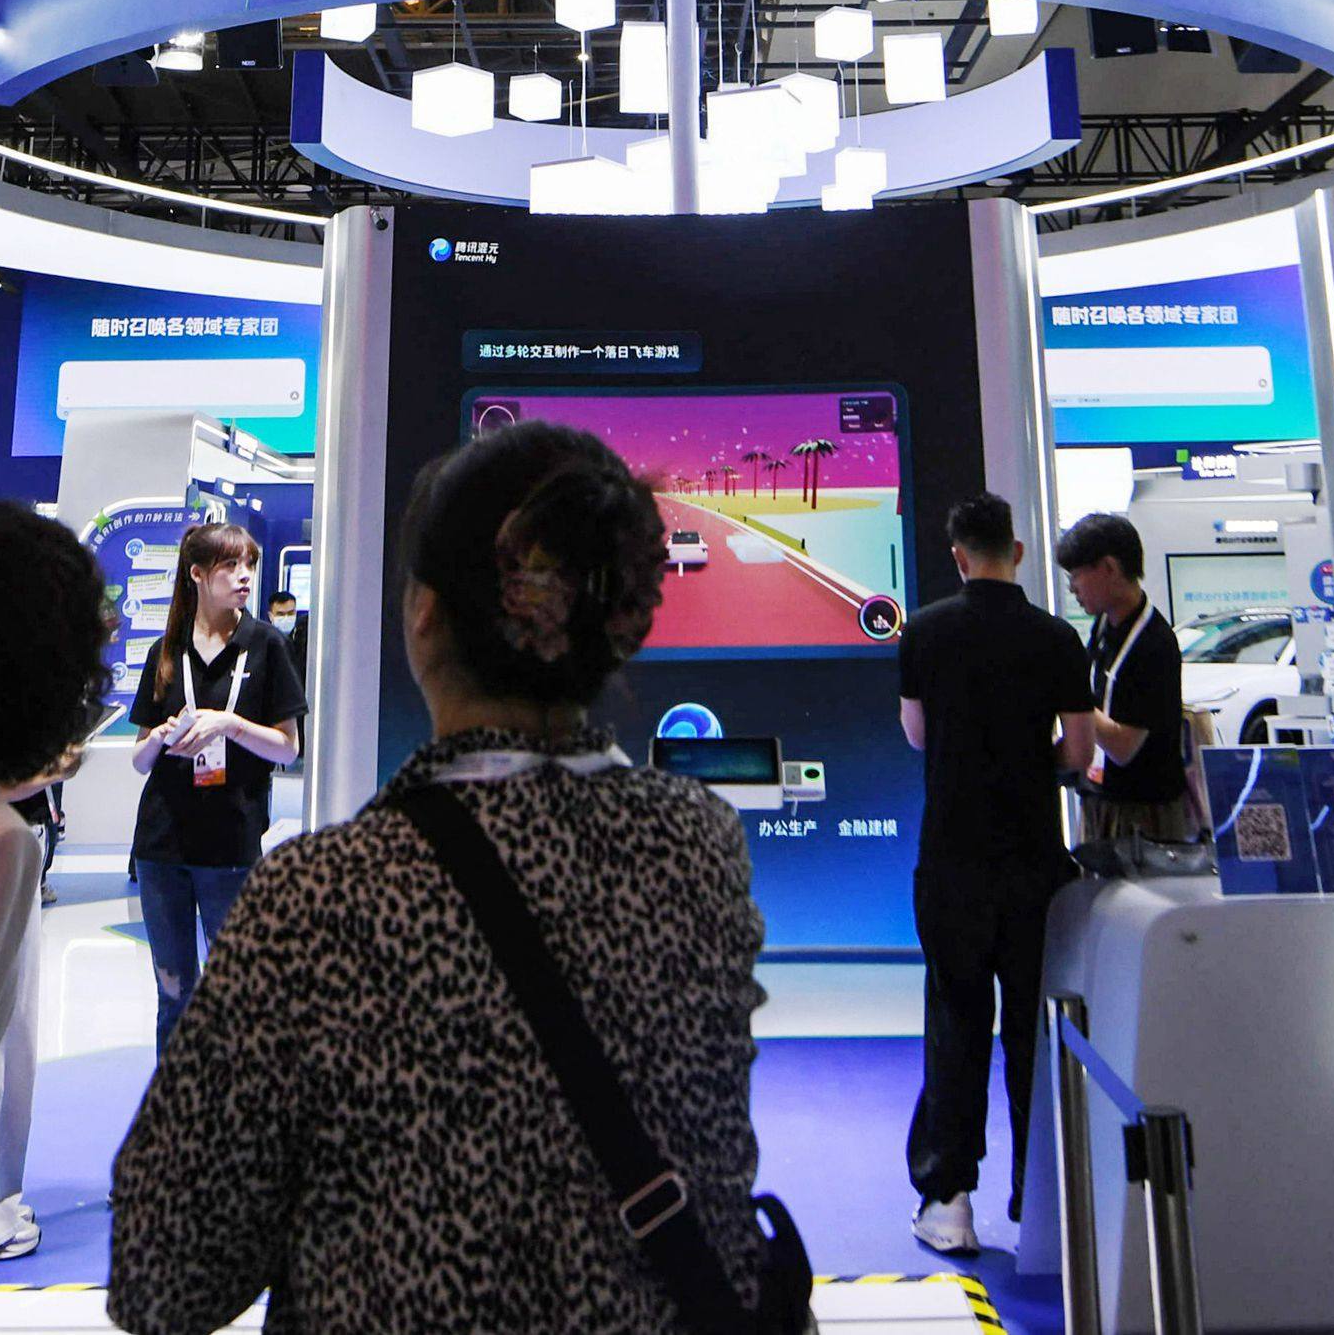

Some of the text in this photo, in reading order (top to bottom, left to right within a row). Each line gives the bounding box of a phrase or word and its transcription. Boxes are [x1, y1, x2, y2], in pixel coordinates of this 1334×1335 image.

[455, 241, 499, 254] 腾讯混元
[455, 253, 484, 262] Tencent
[1051, 304, 1239, 326] 随时召唤各领域专家团
[91, 317, 279, 337] 随时召唤各领域专家团
[479, 344, 680, 359] 通过多轮交互制作一个落日飞车游戏
[758, 819, 817, 837] 办公生产
[838, 819, 898, 837] 金融建模
